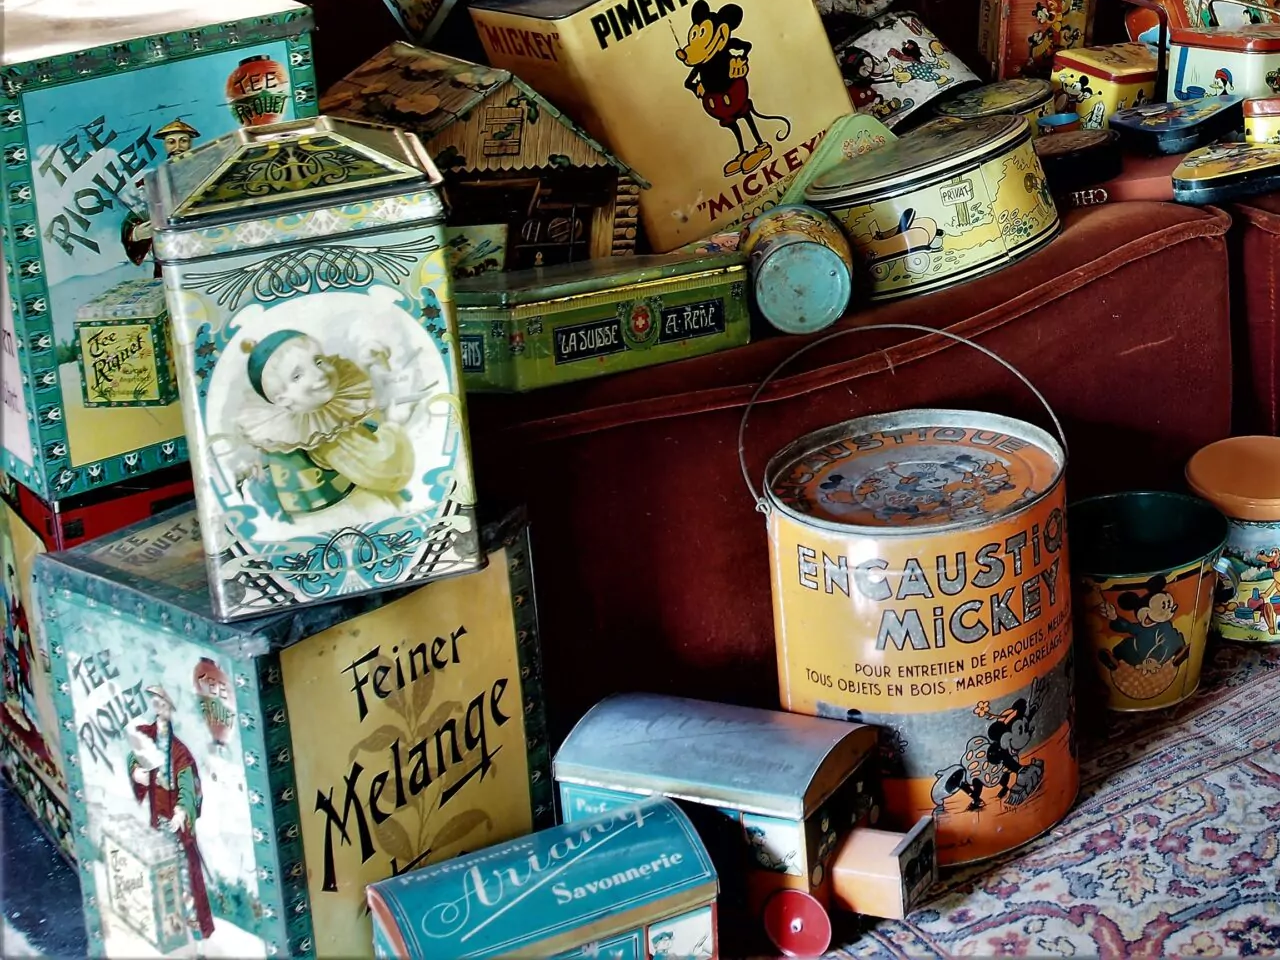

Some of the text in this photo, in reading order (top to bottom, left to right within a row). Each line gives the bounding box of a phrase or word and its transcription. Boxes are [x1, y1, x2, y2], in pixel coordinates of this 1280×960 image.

[234, 70, 278, 95] TEE
[38, 115, 118, 187] TEE
[43, 126, 158, 256] RIQUET
[942, 185, 974, 202] PRIVAT
[560, 332, 577, 355] LA
[101, 535, 149, 559] TEE
[124, 523, 190, 567] RIQUET
[72, 648, 121, 697] TEE
[341, 625, 468, 723] Feiner
[806, 667, 833, 688] TOUS
[838, 679, 882, 696] OBJETS
[887, 684, 904, 697] EN
[854, 663, 891, 679] POUR
[898, 660, 965, 678] ENTRETIEN
[971, 653, 988, 669] DE
[79, 679, 149, 775] RIQUET
[314, 677, 512, 893] Melange
[551, 852, 683, 906] Savonnerie
